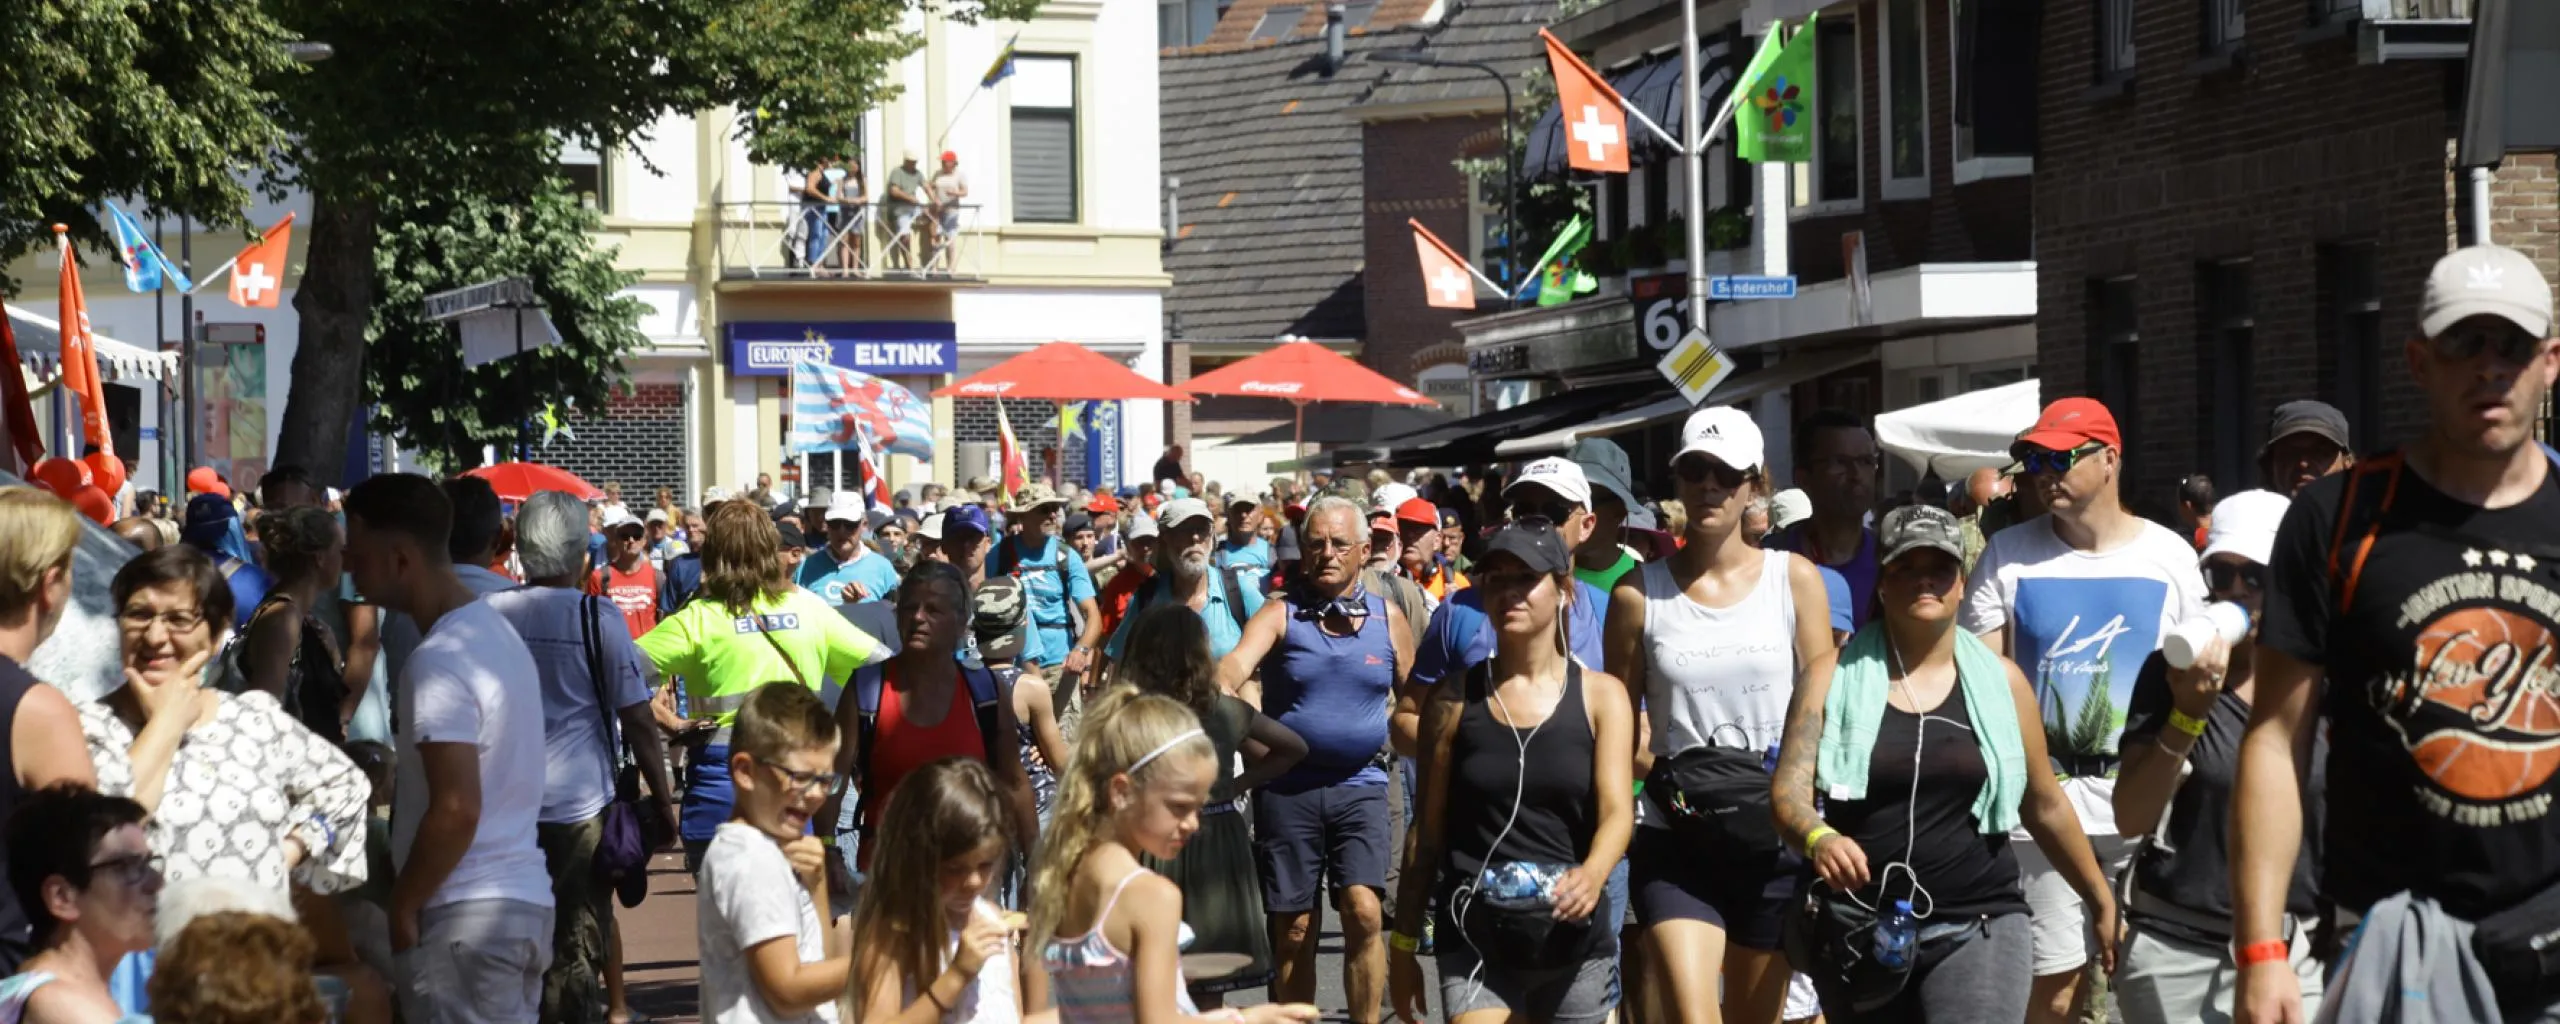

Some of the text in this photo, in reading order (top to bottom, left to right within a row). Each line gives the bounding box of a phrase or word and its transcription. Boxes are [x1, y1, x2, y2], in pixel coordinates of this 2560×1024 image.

[753, 343, 944, 365] EURONICS ELTINK
[2045, 613, 2132, 659] LA
